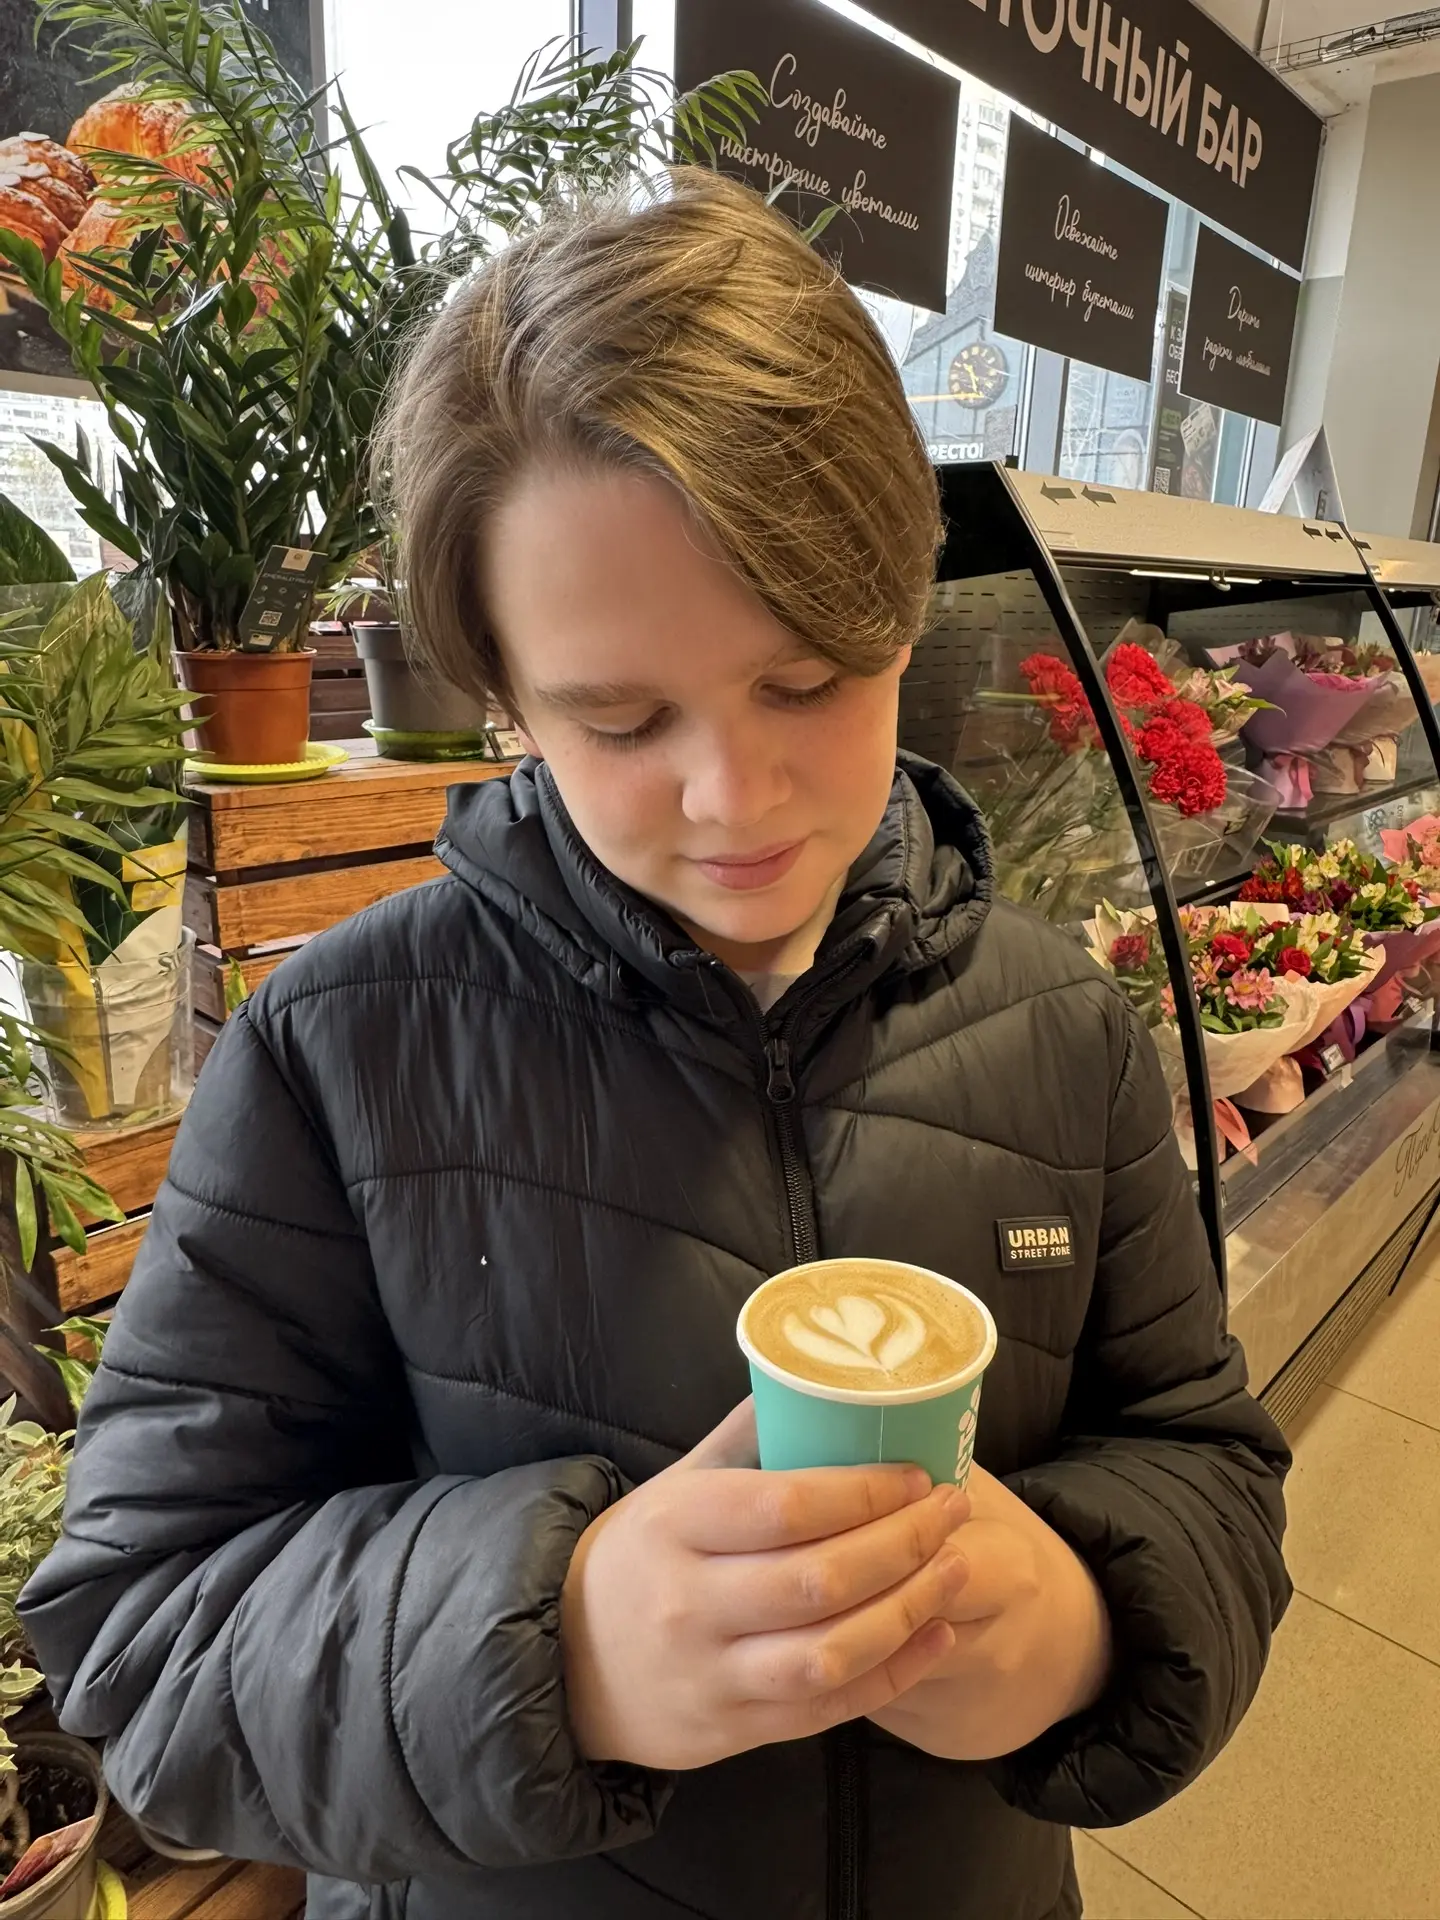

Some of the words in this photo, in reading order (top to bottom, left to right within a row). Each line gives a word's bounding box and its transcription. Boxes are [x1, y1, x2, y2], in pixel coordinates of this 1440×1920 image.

[770, 53, 887, 149] Создавайте
[967, 0, 1192, 147] ОЧНЫЙ
[1196, 83, 1263, 189] БАР
[719, 136, 831, 194] настроение
[841, 169, 919, 230] цветами
[1055, 194, 1118, 260] Освежайте
[1025, 263, 1077, 308] интерьер
[1082, 280, 1135, 322] букетами
[1008, 1226, 1070, 1248] URBAN
[1010, 1247, 1047, 1259] STREET
